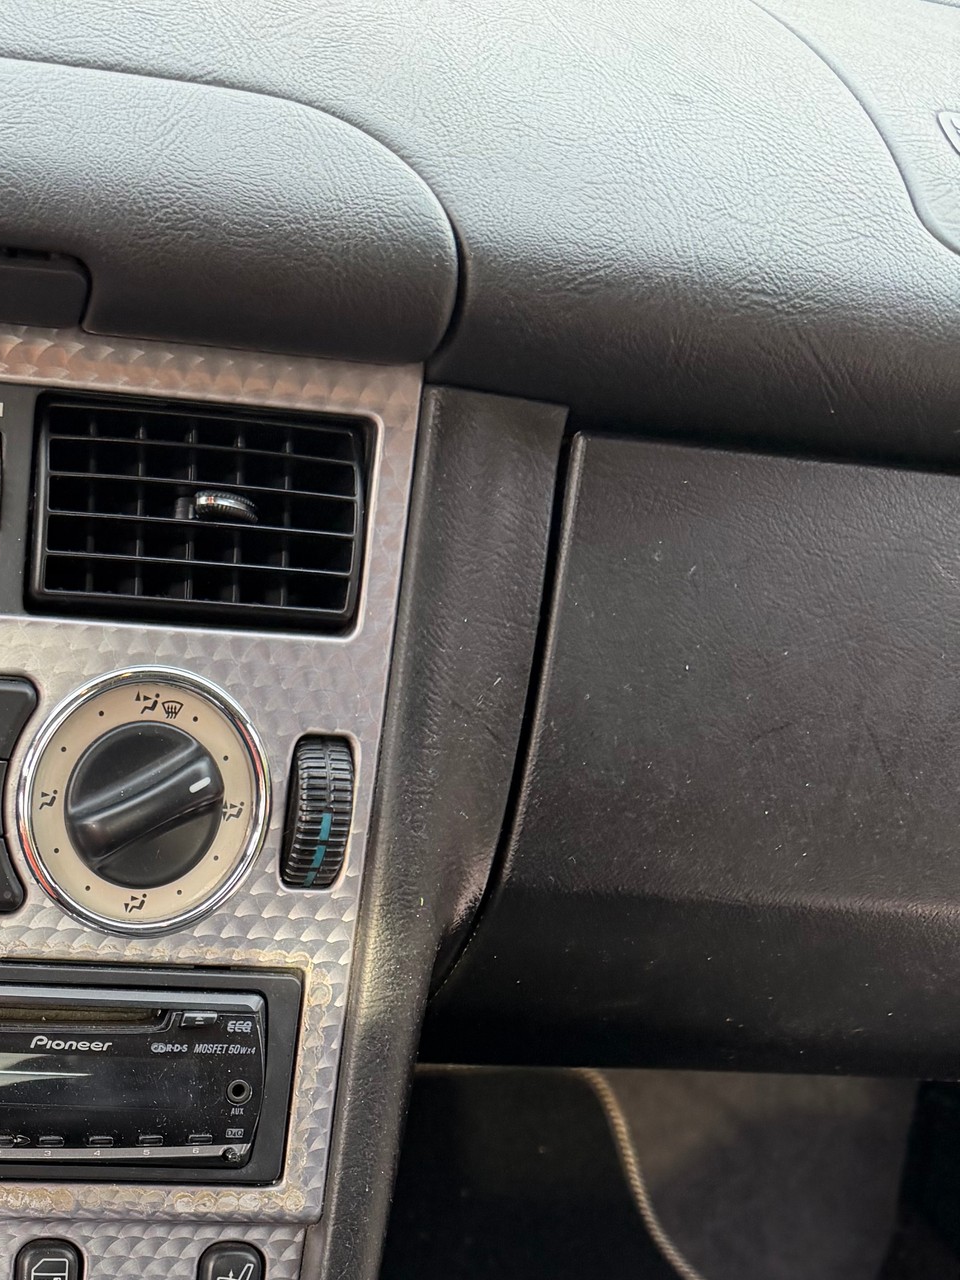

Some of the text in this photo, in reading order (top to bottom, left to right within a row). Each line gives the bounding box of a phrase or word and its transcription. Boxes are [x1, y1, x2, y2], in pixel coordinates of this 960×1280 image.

[30, 1035, 113, 1051] Pioneer
[193, 1043, 229, 1054] MOSFET
[230, 1107, 244, 1116] AUX
